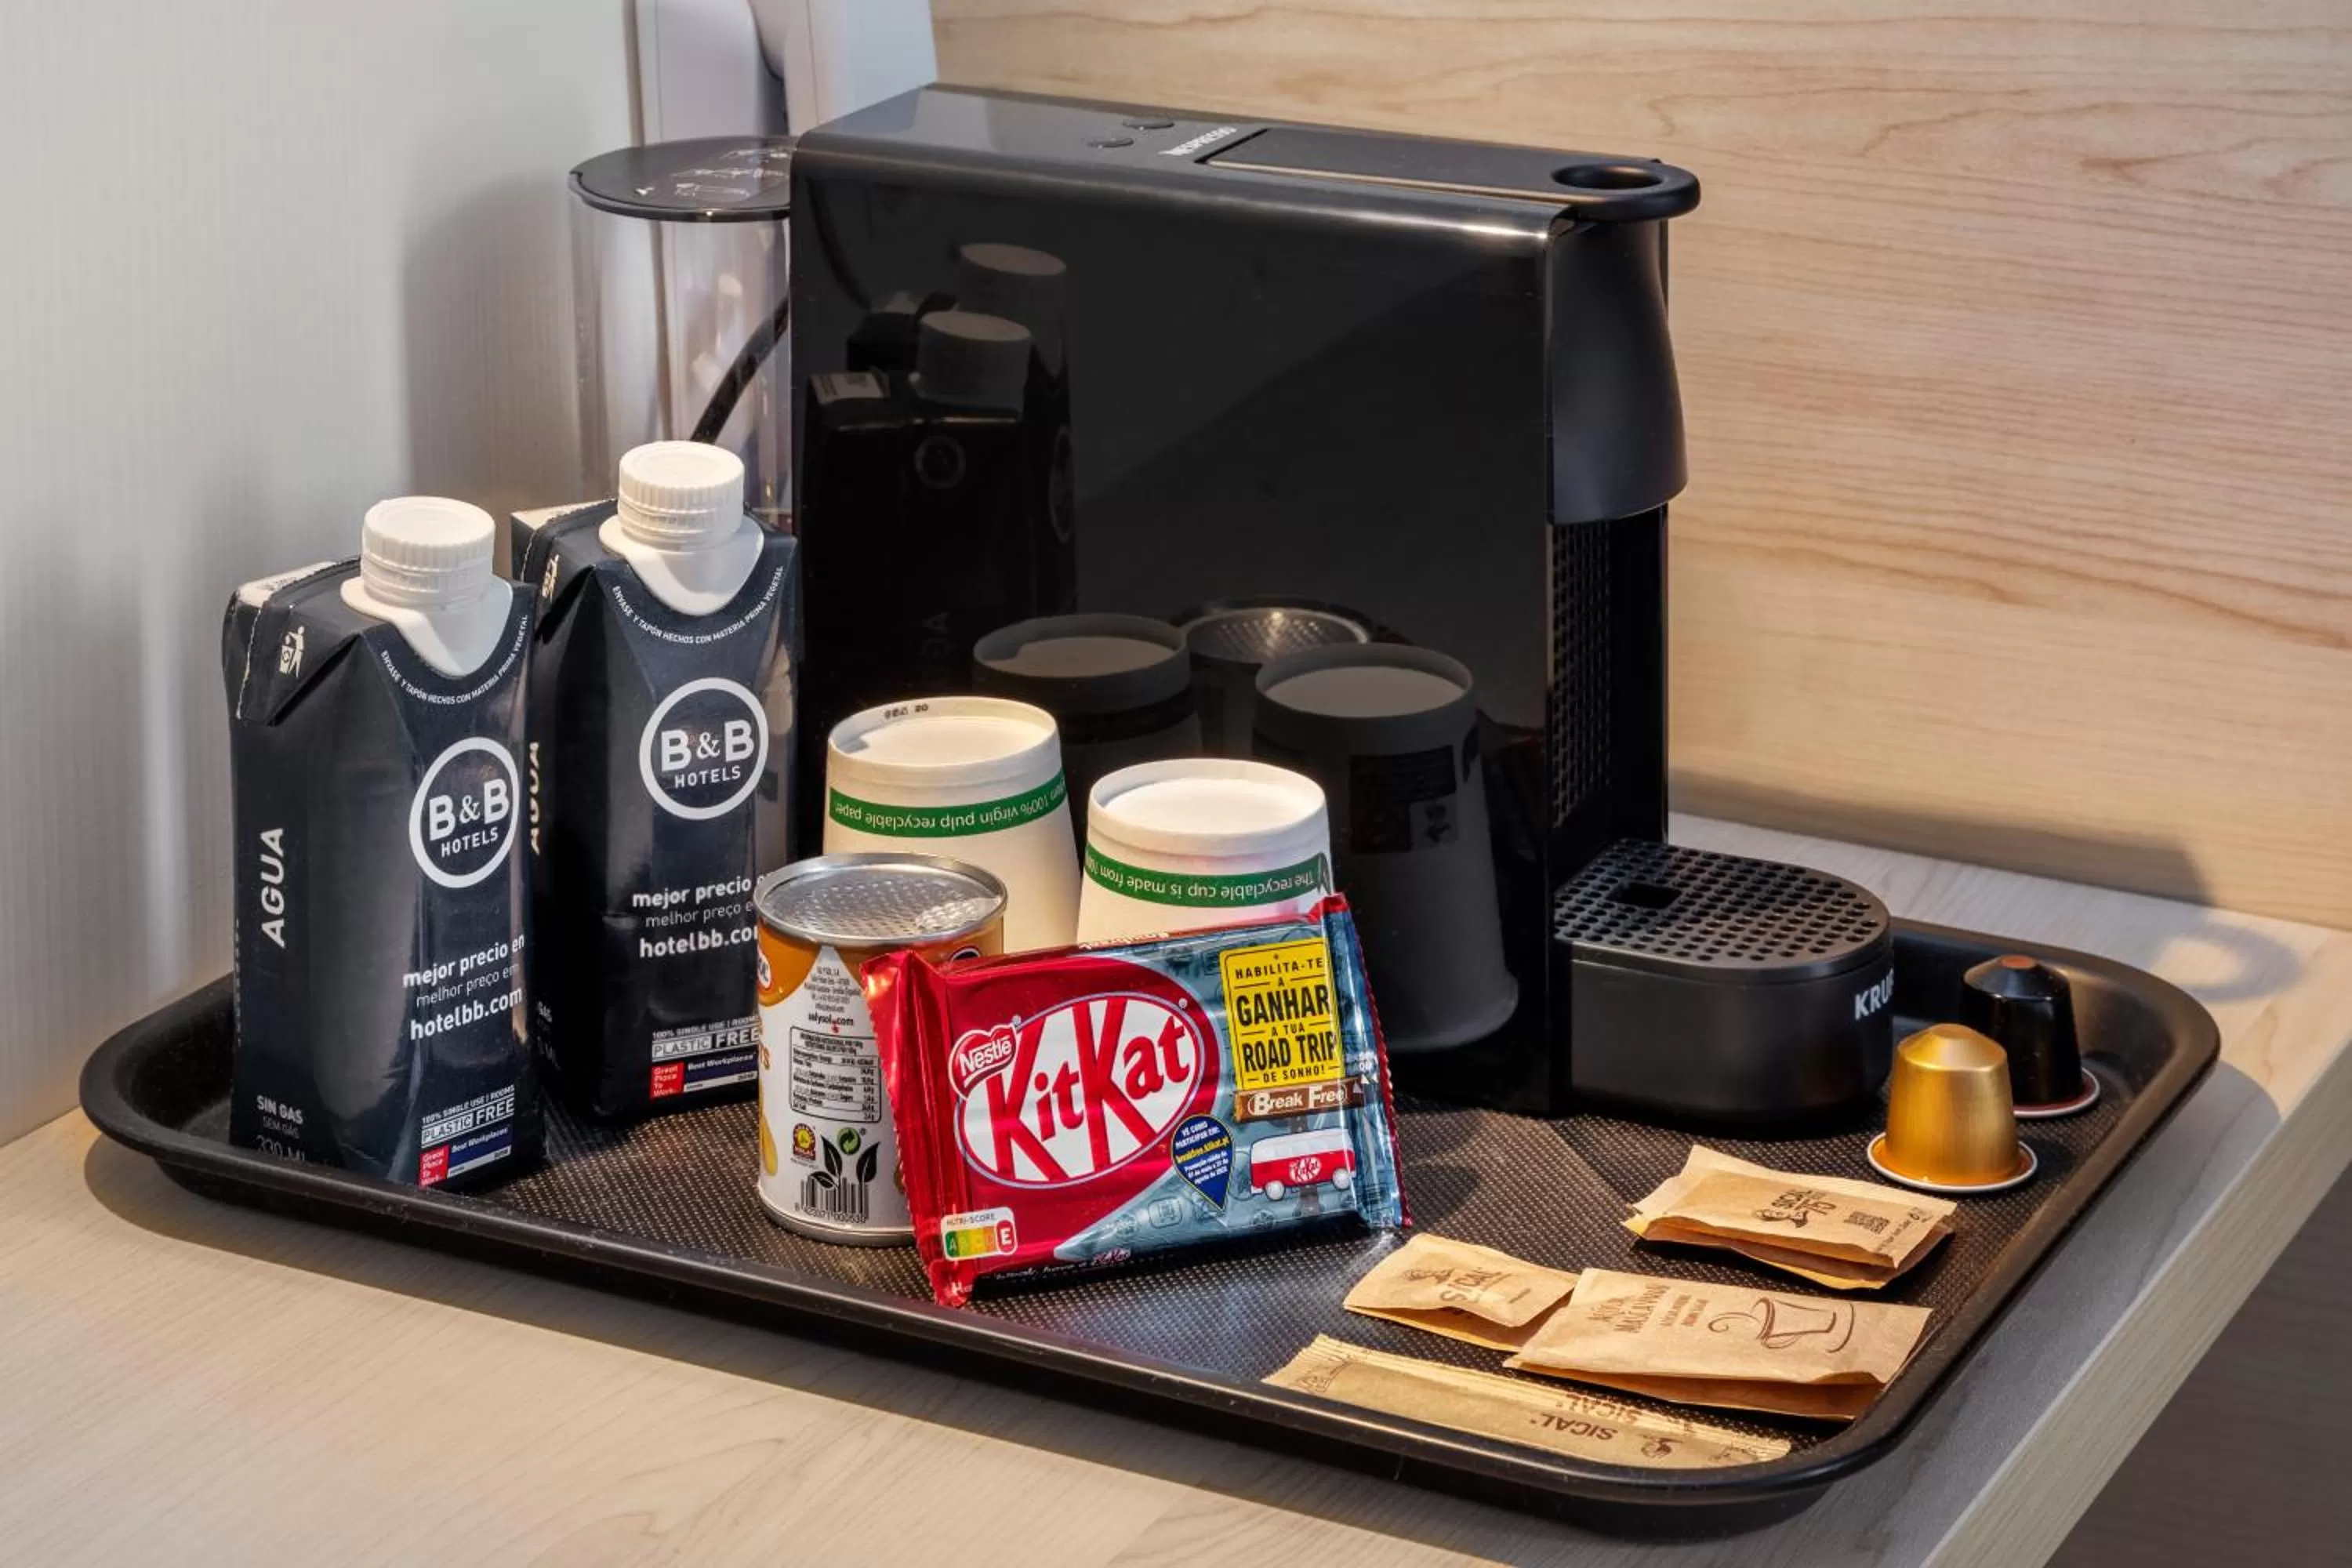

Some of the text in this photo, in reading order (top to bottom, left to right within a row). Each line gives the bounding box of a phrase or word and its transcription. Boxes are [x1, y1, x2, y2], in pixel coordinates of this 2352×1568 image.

[612, 586, 634, 618] ENVASE
[662, 632, 694, 644] HECHOS
[695, 634, 712, 644] CON
[713, 619, 746, 640] MATERIA
[745, 601, 767, 622] PRIMA
[764, 566, 783, 601] VEGETAL
[456, 693, 470, 703] CON
[661, 719, 754, 772] B&B
[674, 765, 741, 789] HOTELS
[429, 779, 510, 841] B&B
[980, 806, 1019, 824] virgin
[1020, 794, 1049, 814] 100%
[865, 811, 936, 829] recyclable
[940, 815, 975, 832] pulp
[441, 826, 499, 858] HOTELS
[260, 827, 285, 949] AGUA
[1100, 865, 1123, 887] from
[1127, 875, 1166, 894] made
[1221, 877, 1294, 898] recyclable
[1294, 870, 1314, 887] The
[632, 887, 691, 910] mejor
[695, 875, 752, 905] precio
[1171, 882, 1181, 898] is
[1187, 885, 1216, 898] cup
[645, 901, 753, 927] melhor preço e
[402, 934, 524, 989] mejor precio en
[1235, 957, 1324, 980] HABILITA-TE
[416, 984, 463, 1008] melhor
[466, 971, 499, 996] preço
[1278, 977, 1285, 987] A
[410, 987, 522, 1040] hotelbb.com
[1236, 984, 1330, 1027] GANHAR
[1272, 1022, 1305, 1036] A TUA
[653, 1027, 760, 1058] PLASTIC FREE
[1241, 1037, 1291, 1073] ROAD
[1295, 1031, 1336, 1064] TRIP
[1263, 1065, 1326, 1083] DE SONHO!
[985, 997, 1189, 1181] KitKat
[1254, 1085, 1343, 1116] Break Free
[256, 1094, 303, 1124] SIN GAS
[423, 1097, 515, 1144] PLASTIC FREE
[1000, 1227, 1011, 1245] E
[1541, 1413, 1618, 1440] SICAL
